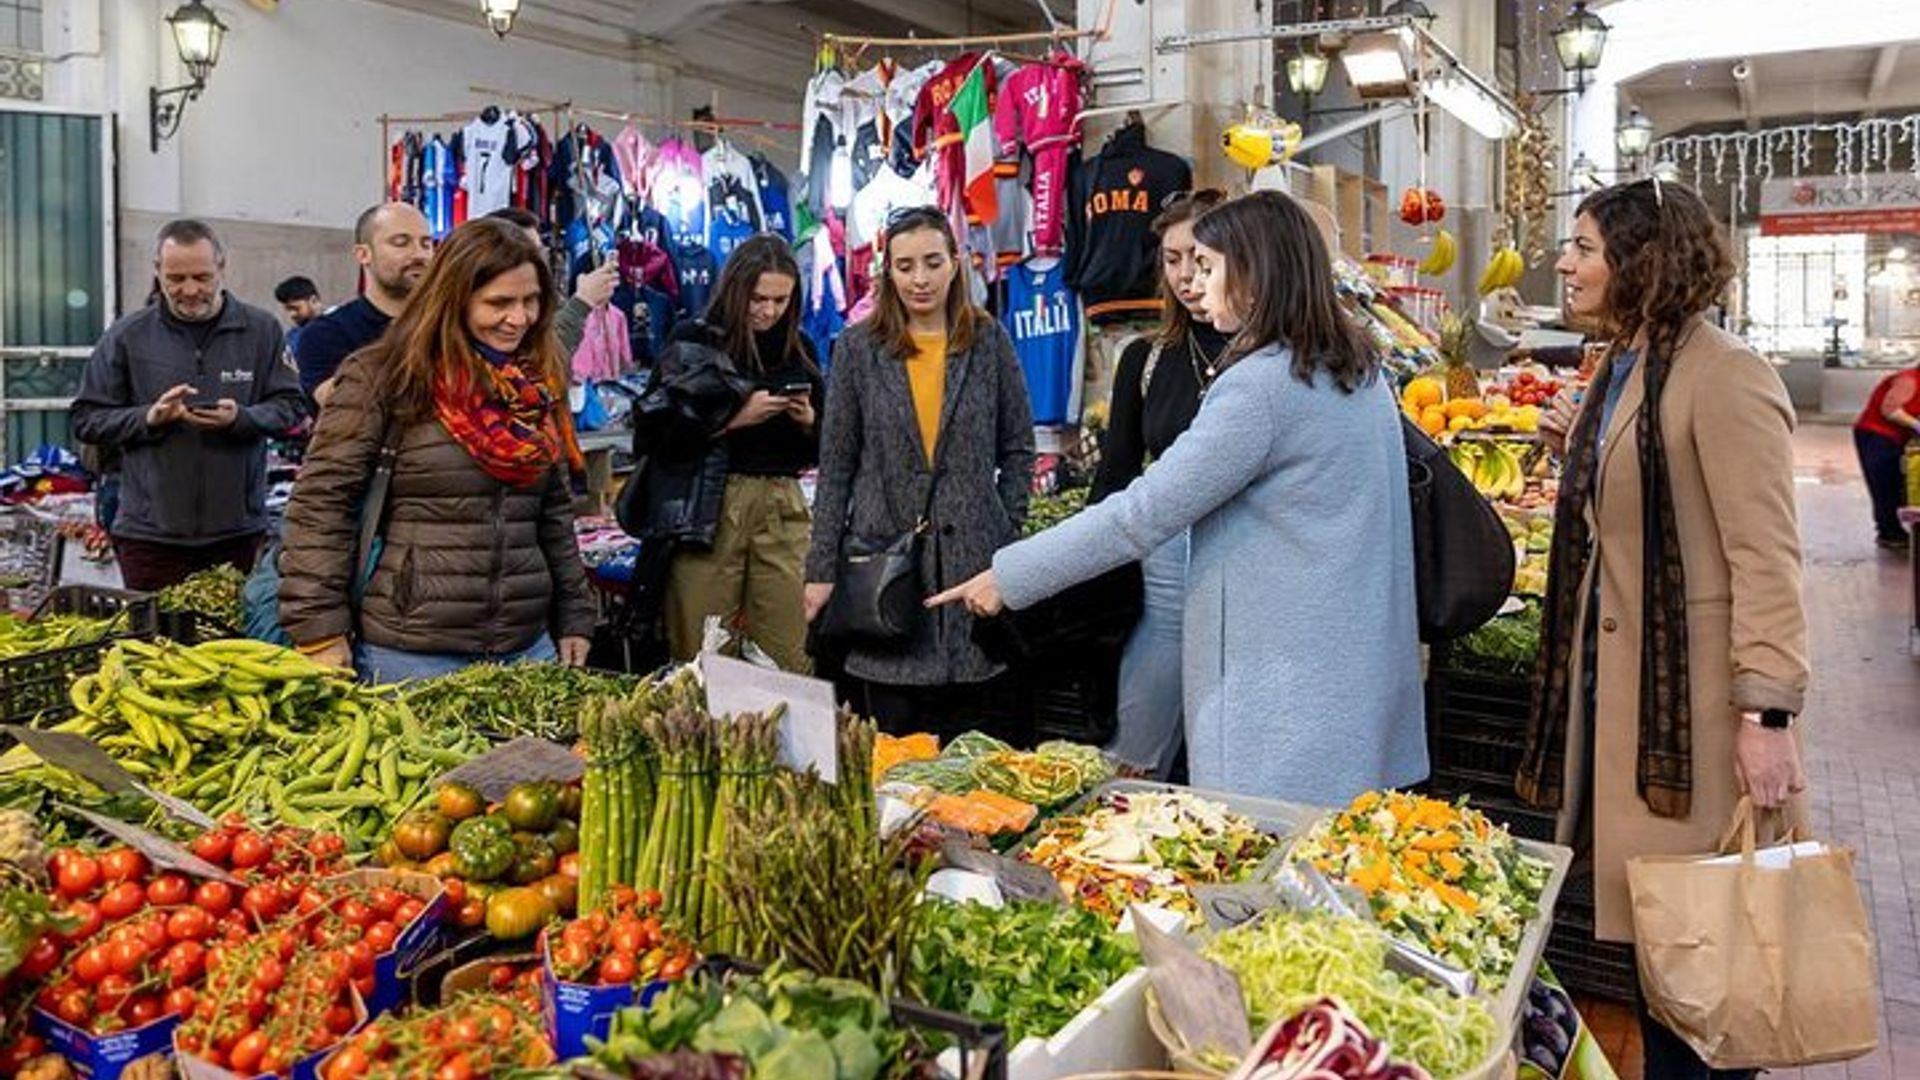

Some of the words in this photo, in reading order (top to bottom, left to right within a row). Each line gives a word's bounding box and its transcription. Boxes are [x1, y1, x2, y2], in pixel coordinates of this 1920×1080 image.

[480, 152, 492, 194] 7
[1036, 171, 1051, 230] ITALIA
[1014, 303, 1071, 339] ITALIA
